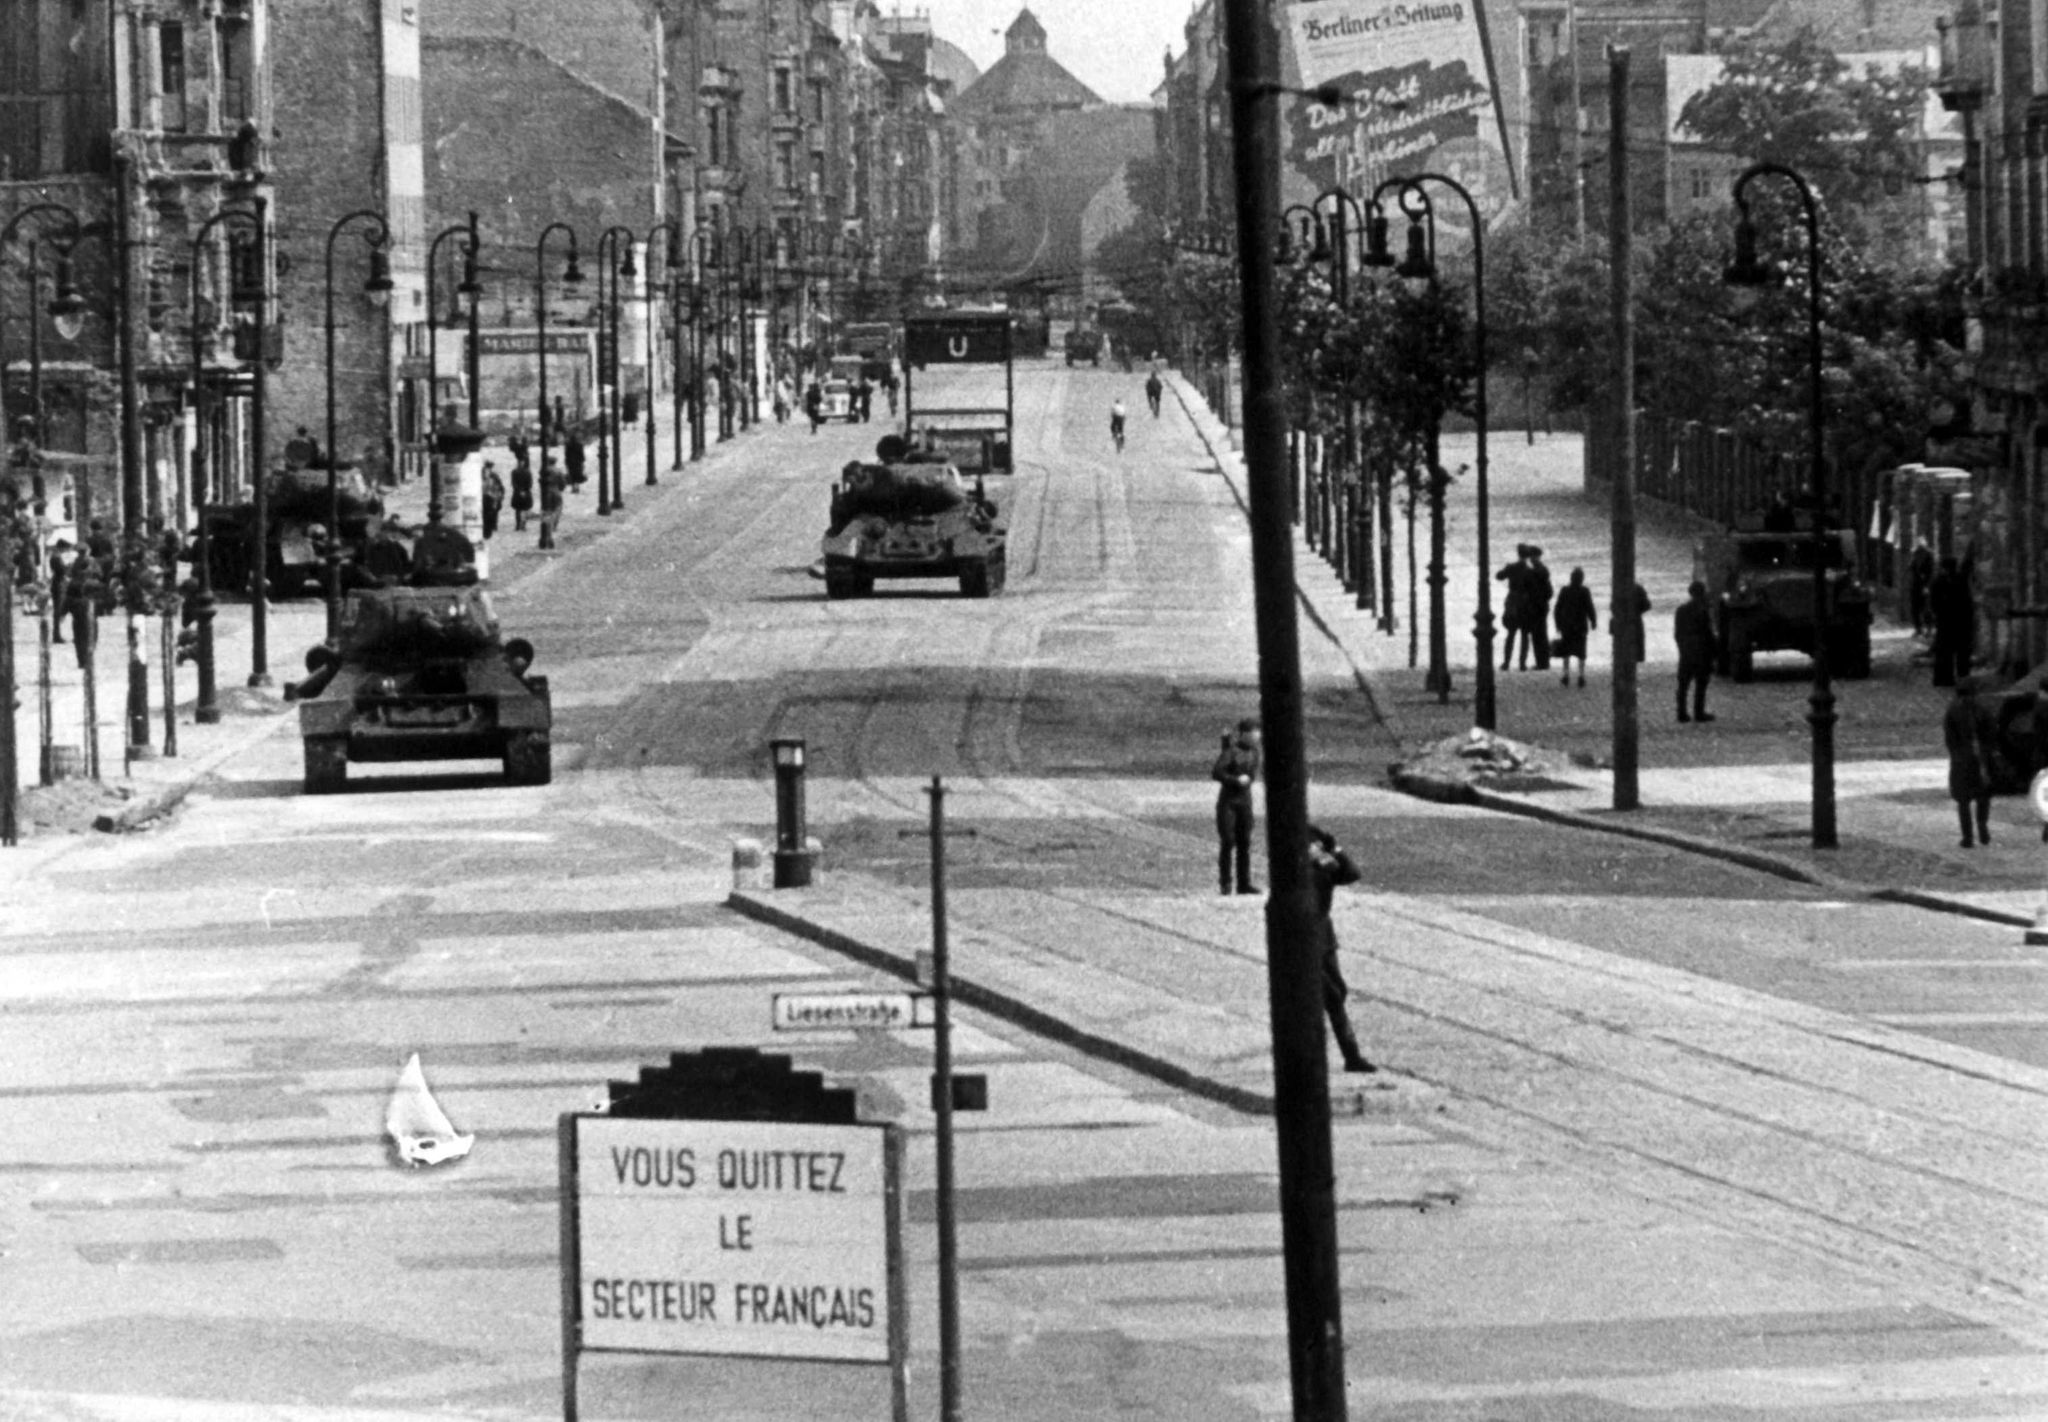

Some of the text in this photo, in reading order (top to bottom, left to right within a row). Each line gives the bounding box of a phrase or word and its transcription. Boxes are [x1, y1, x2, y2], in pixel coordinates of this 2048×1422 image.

[1302, 3, 1464, 40] Berliner Zeitung
[1305, 103, 1346, 129] Das
[949, 336, 968, 358] U
[787, 1001, 900, 1025] Liesenstraße
[612, 1147, 846, 1192] VOUS QUITTEZ
[719, 1215, 753, 1251] LE
[593, 1279, 875, 1329] SECTEUR FRANÇAIS
